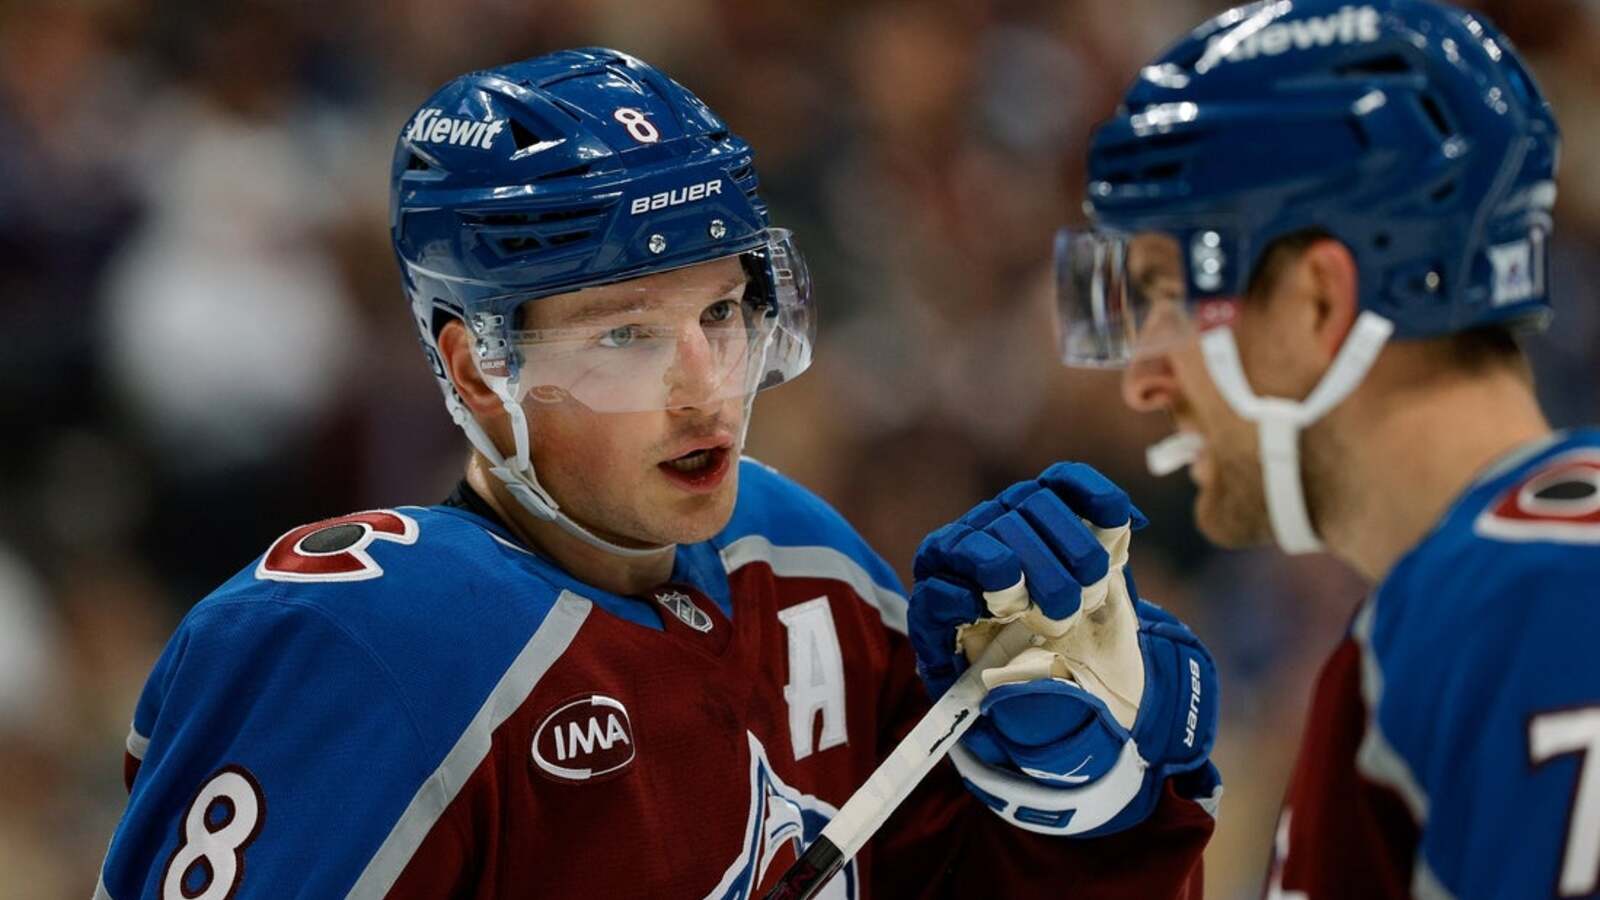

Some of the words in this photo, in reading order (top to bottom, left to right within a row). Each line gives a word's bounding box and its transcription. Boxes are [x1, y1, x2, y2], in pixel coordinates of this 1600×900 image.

[1205, 5, 1381, 63] iewit
[406, 108, 504, 150] Kiewit
[614, 107, 659, 144] 8
[777, 596, 848, 761] A
[553, 713, 630, 761] IMA
[162, 765, 265, 900] 8
